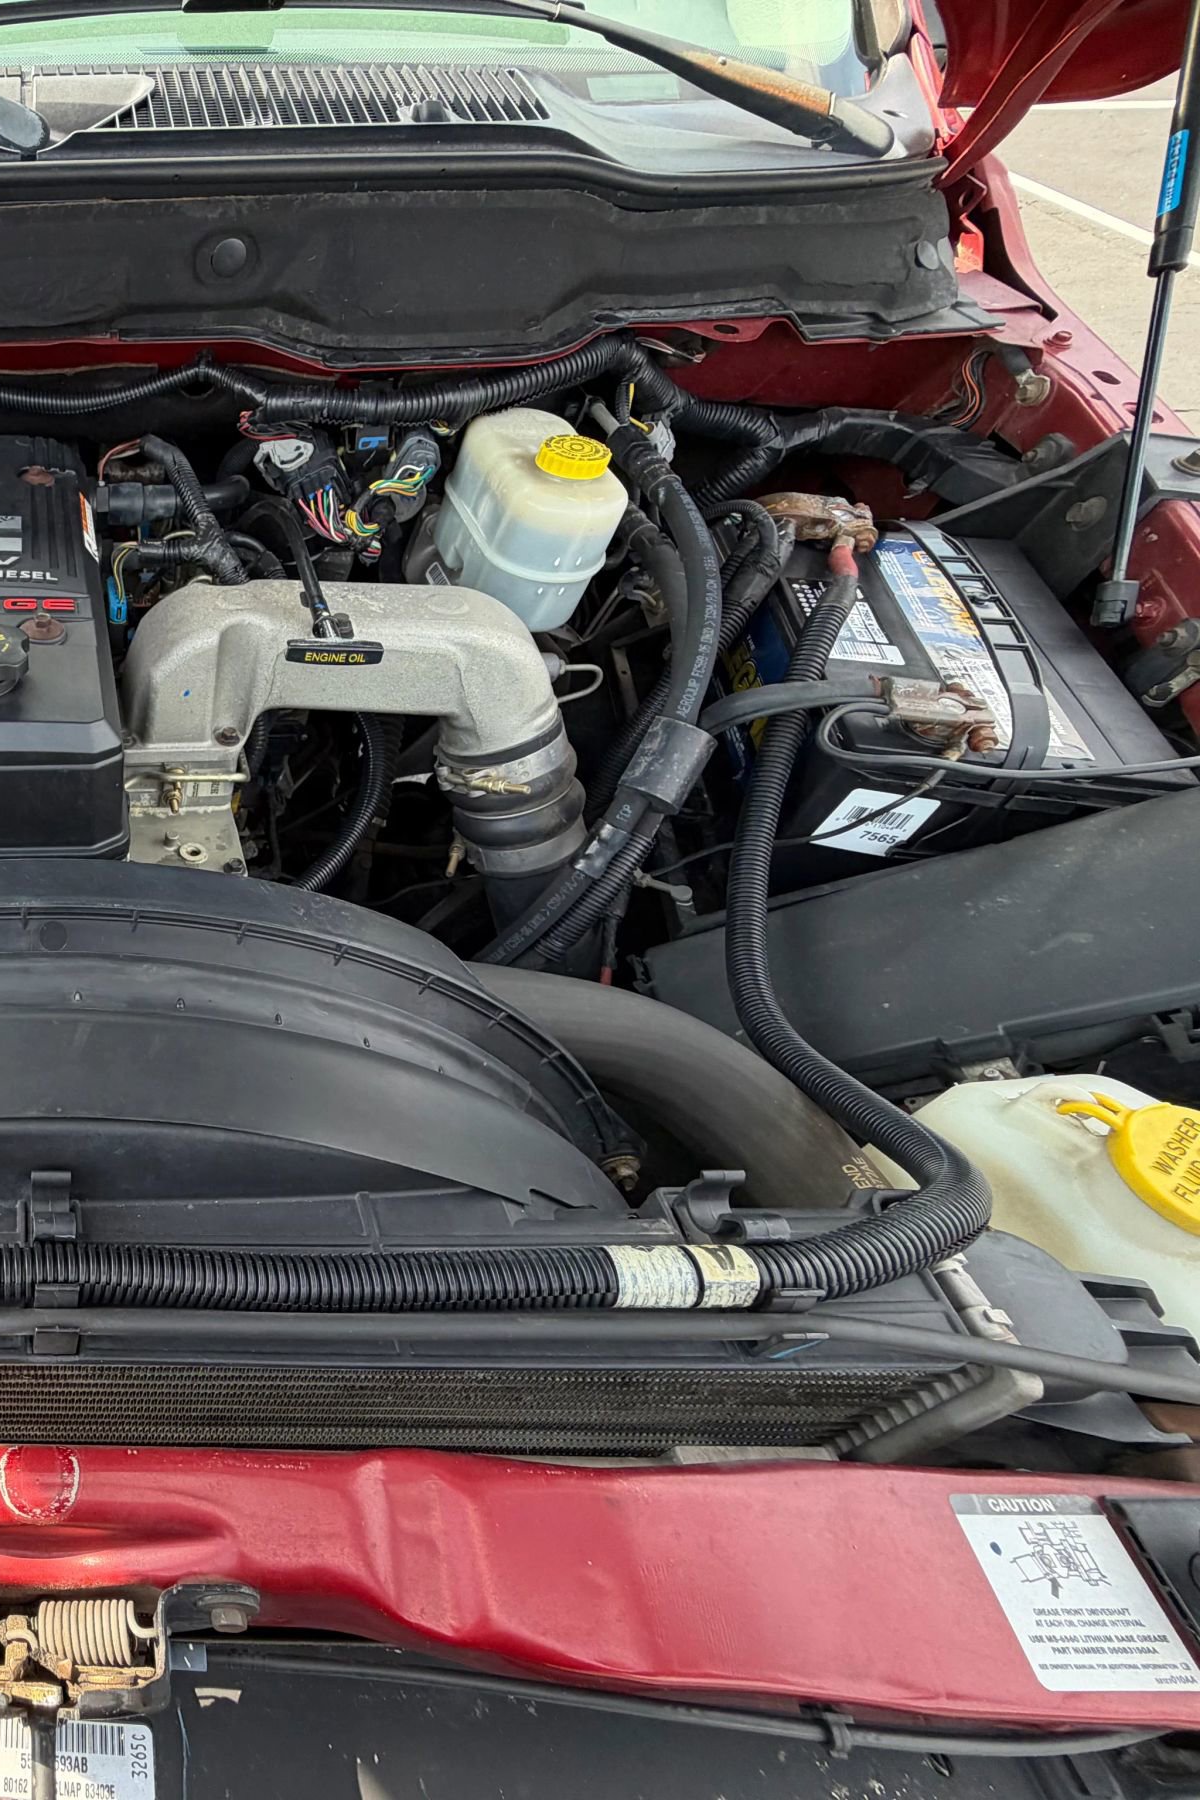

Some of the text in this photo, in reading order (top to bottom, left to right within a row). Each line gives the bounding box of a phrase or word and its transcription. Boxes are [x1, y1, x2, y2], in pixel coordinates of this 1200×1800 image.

[304, 652, 366, 663] ENGINE OIL
[859, 830, 899, 845] 7565
[1151, 1117, 1200, 1176] WASHER
[842, 1164, 873, 1189] END
[988, 1497, 1057, 1513] CAUTION
[1032, 1607, 1132, 1617] GREASE FRONT DRIVESHAFT
[1035, 1618, 1146, 1628] AT EACH OIL CHANGE INTERVAL
[1028, 1634, 1046, 1644] USE
[1079, 1634, 1114, 1644] LITHIUM
[1113, 1634, 1137, 1644] BASE
[1136, 1634, 1171, 1644] GREASE
[1051, 1646, 1072, 1656] PART
[1073, 1646, 1108, 1656] NUMBER
[131, 1733, 148, 1780] 3265C
[3, 1775, 28, 1794] 80162
